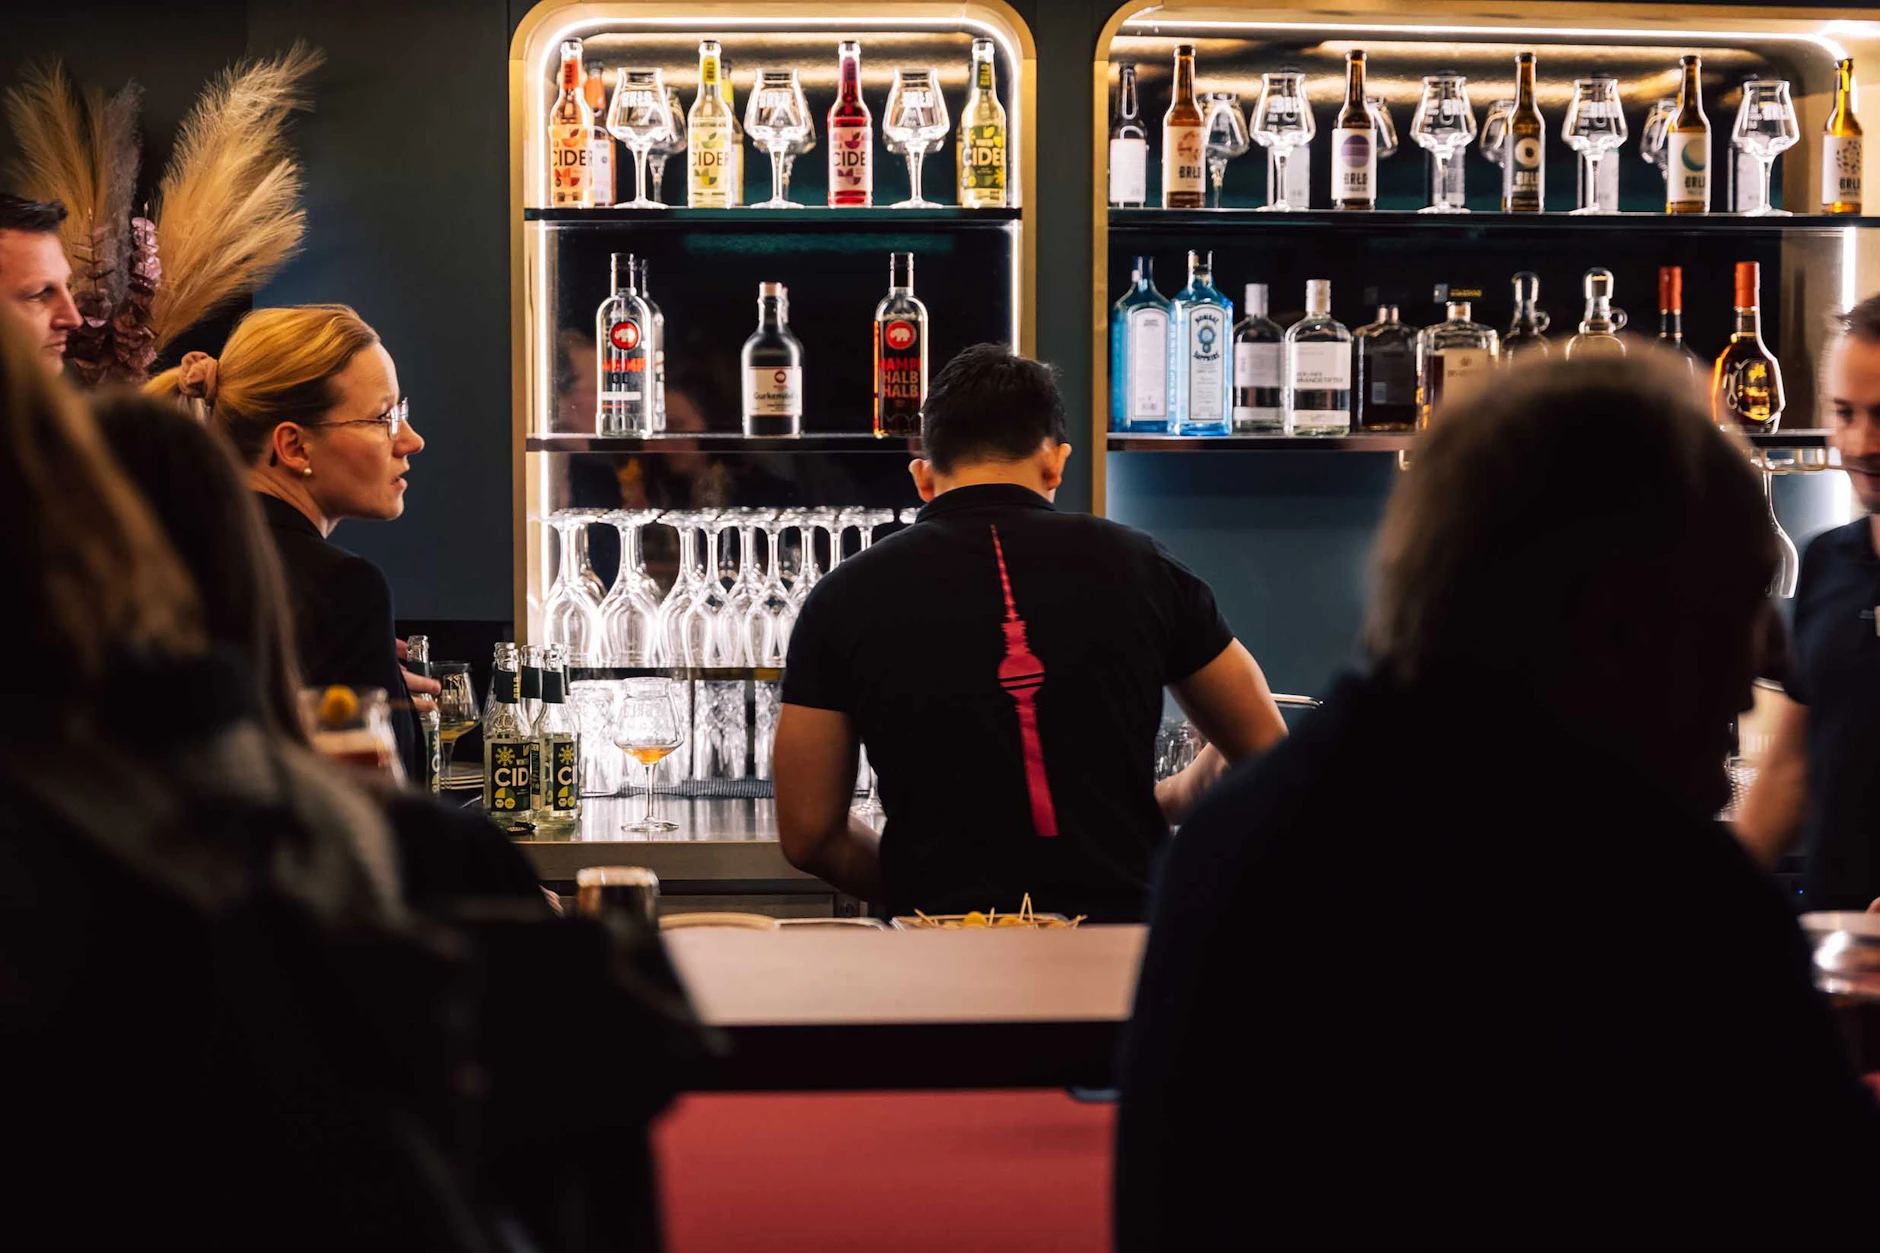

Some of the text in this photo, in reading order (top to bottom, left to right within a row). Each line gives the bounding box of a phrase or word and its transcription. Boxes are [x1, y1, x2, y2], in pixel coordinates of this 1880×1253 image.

[882, 370, 919, 384] HALB
[882, 384, 919, 398] HALB
[494, 767, 530, 787] CID
